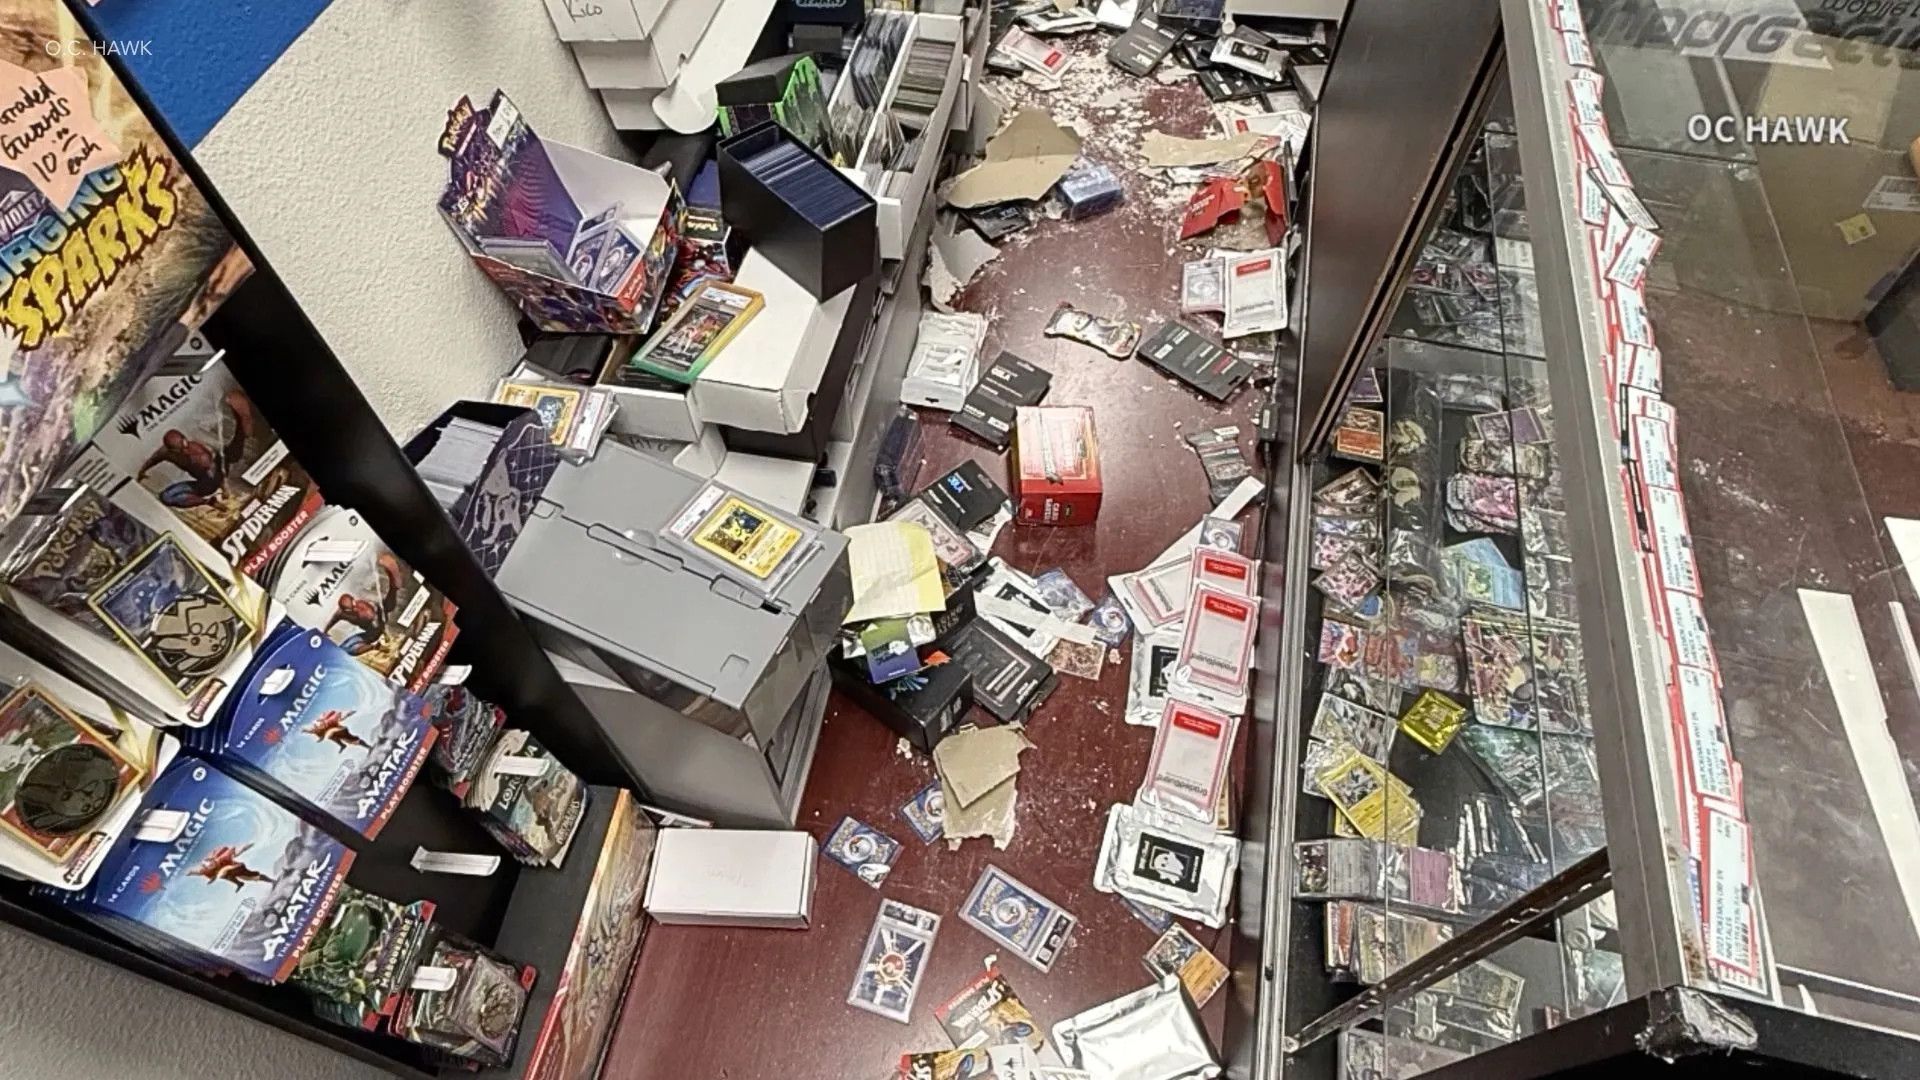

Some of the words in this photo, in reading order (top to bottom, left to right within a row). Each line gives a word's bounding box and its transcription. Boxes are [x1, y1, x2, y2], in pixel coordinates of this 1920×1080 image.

[0, 97, 71, 160] Guards
[68, 136, 102, 175] each
[0, 152, 176, 349] SPARKS
[243, 549, 268, 574] PLAY
[268, 510, 309, 552] BOOSTER
[422, 640, 449, 679] BOOSTER
[279, 663, 328, 732] MAGIC
[356, 727, 418, 819] AVATAR
[381, 794, 399, 820] PLAY
[397, 747, 427, 793] BOOSTER
[158, 798, 216, 878] MAGIC
[117, 865, 140, 893] CARDS
[263, 853, 332, 962] AVATAR
[278, 942, 292, 957] THE
[305, 865, 335, 914] AIRBENDER
[292, 928, 314, 958] PLAY
[311, 872, 343, 926] BOOSTER
